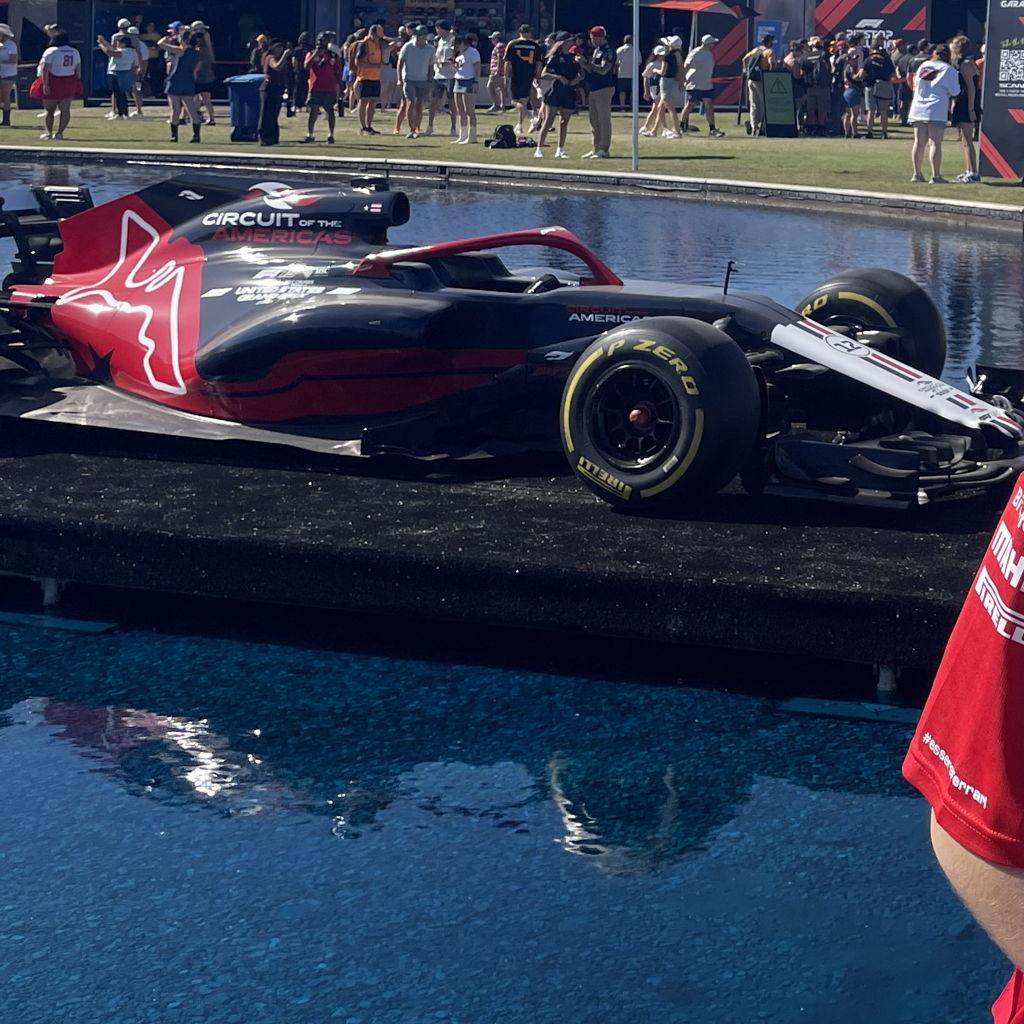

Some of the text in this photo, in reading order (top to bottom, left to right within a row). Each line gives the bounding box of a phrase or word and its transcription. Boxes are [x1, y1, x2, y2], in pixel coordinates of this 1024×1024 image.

[63, 55, 74, 67] 81
[515, 49, 535, 65] 4
[201, 212, 342, 228] CIRCUIT OF THE
[211, 227, 352, 246] AMERICAS
[568, 313, 646, 323] AMERICA
[833, 340, 862, 353] 12
[607, 339, 700, 396] P ZERO
[576, 456, 632, 501] PIRELLI
